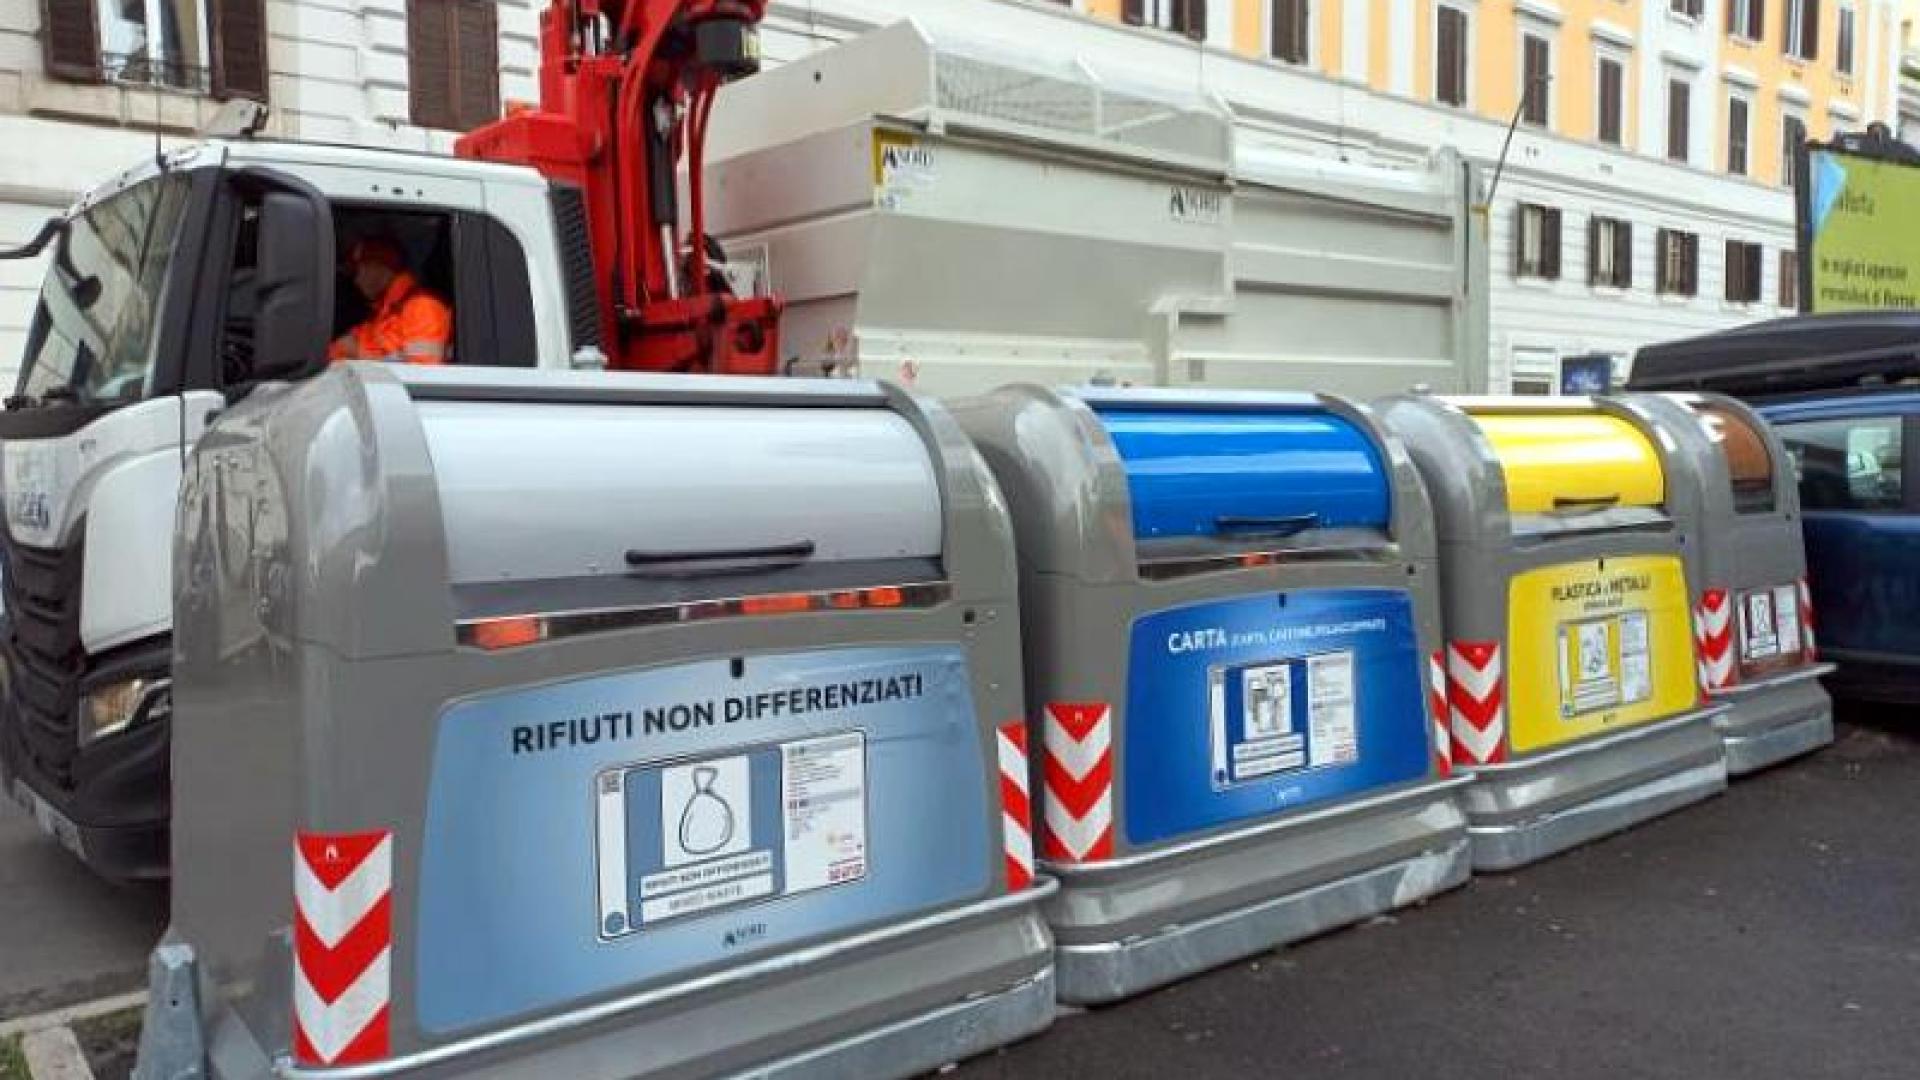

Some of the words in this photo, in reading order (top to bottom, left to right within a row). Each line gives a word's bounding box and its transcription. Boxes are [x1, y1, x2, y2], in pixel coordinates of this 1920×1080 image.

[1168, 628, 1227, 653] CARTA
[511, 710, 633, 755] RIFIUTI
[642, 701, 715, 736] NON
[724, 672, 923, 724] DIFFERENZIATI
